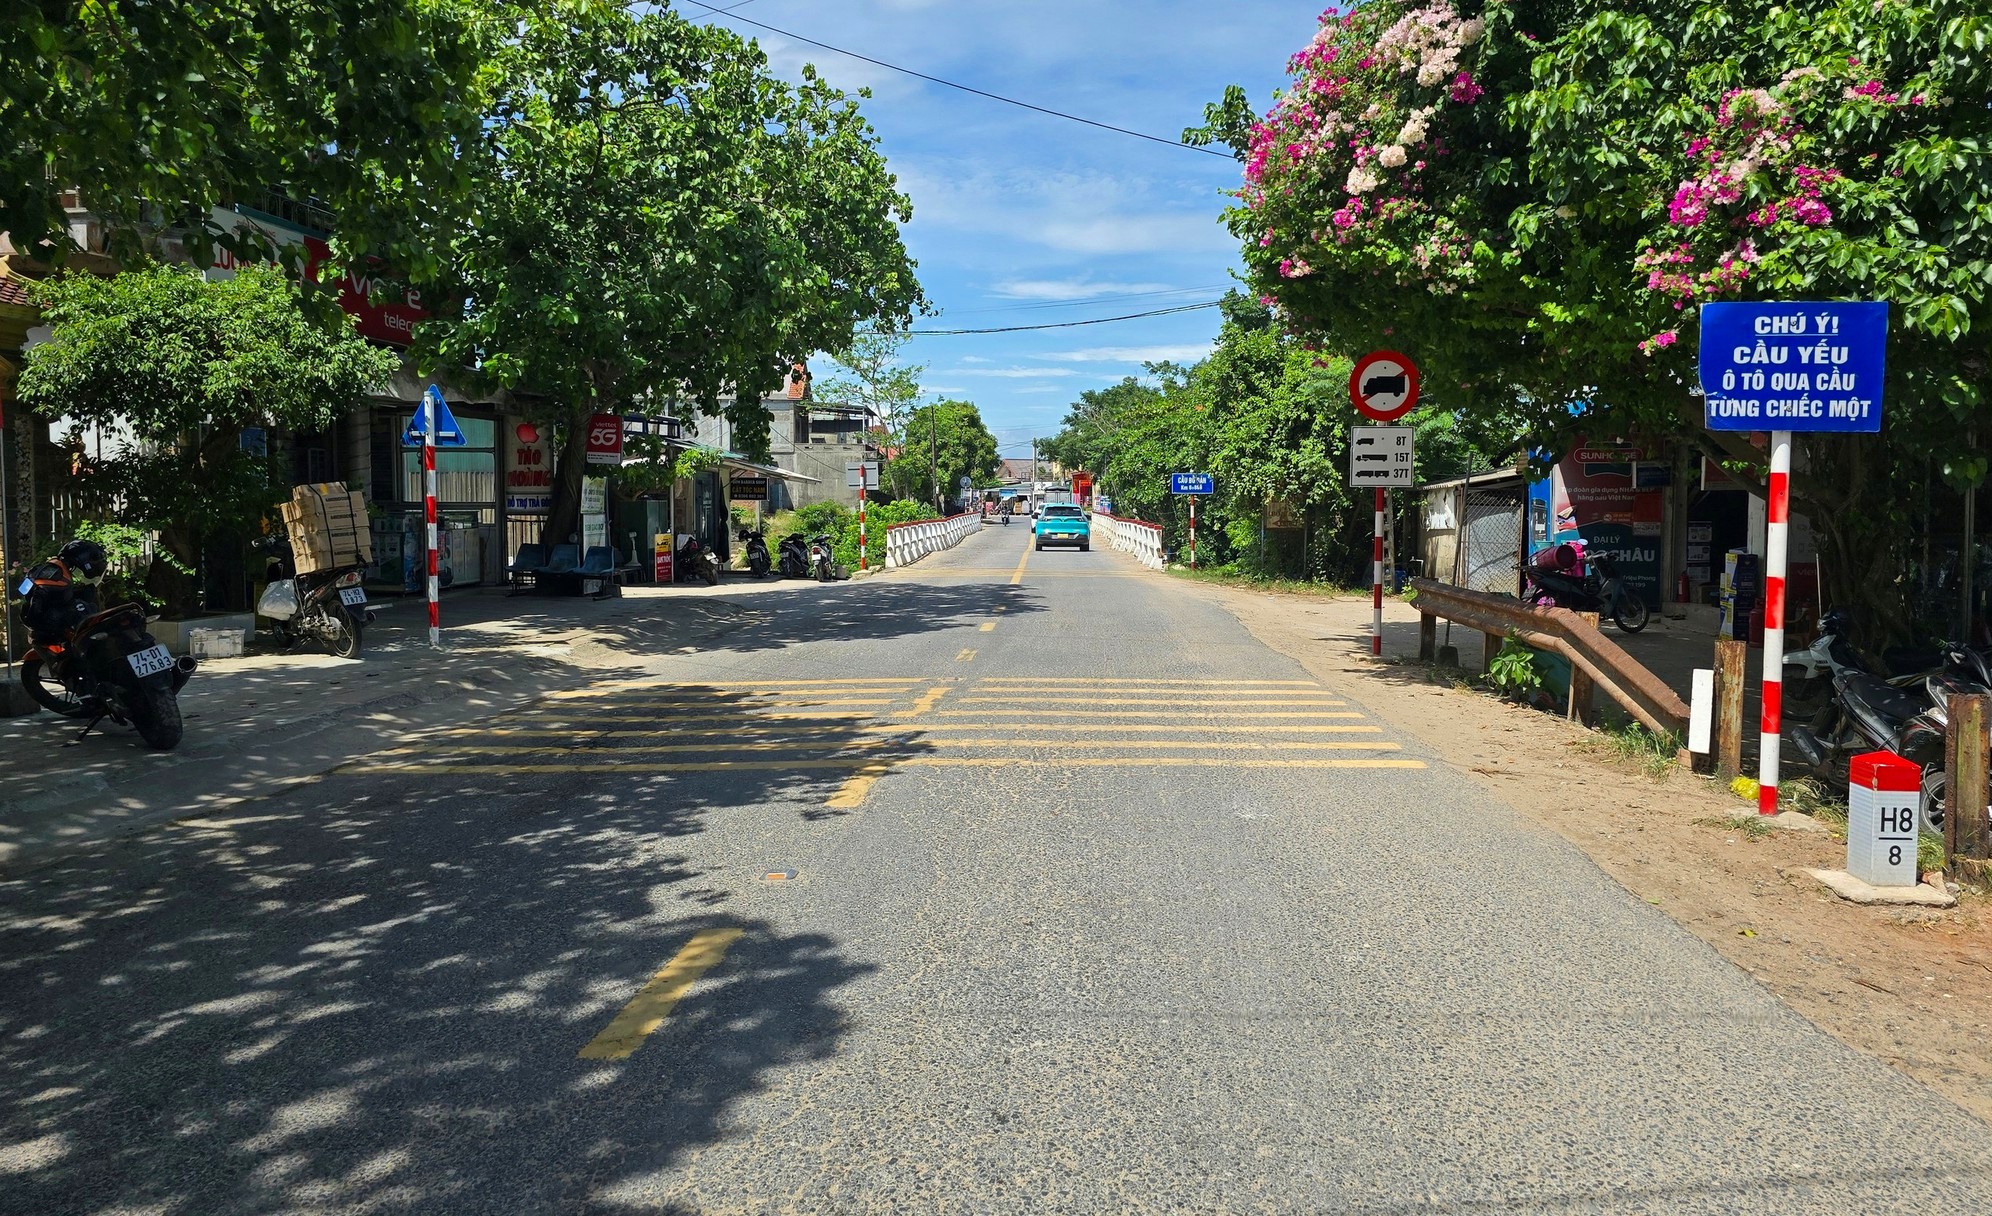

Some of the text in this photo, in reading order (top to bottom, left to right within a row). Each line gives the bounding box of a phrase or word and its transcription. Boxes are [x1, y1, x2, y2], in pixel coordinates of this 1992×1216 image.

[1754, 312, 1839, 334] CHÚ Ý!
[1733, 338, 1849, 364] CẦU YẾU
[1722, 366, 1856, 392] Ô TÔ QUA CẦU
[1708, 393, 1872, 421] TỪNG CHIẾC MỘT
[590, 428, 617, 446] 5G
[1396, 436, 1407, 446] 8T
[1394, 452, 1410, 462] 15T
[1580, 452, 1636, 460] SUNHOSE
[1178, 474, 1188, 484] CẦU
[1393, 468, 1409, 478] 37T
[1593, 534, 1621, 545] ĐẠI LÝ
[133, 647, 163, 664] 74-D1
[135, 656, 172, 676] 276.83
[1880, 807, 1913, 832] H8
[1888, 845, 1902, 866] 8
